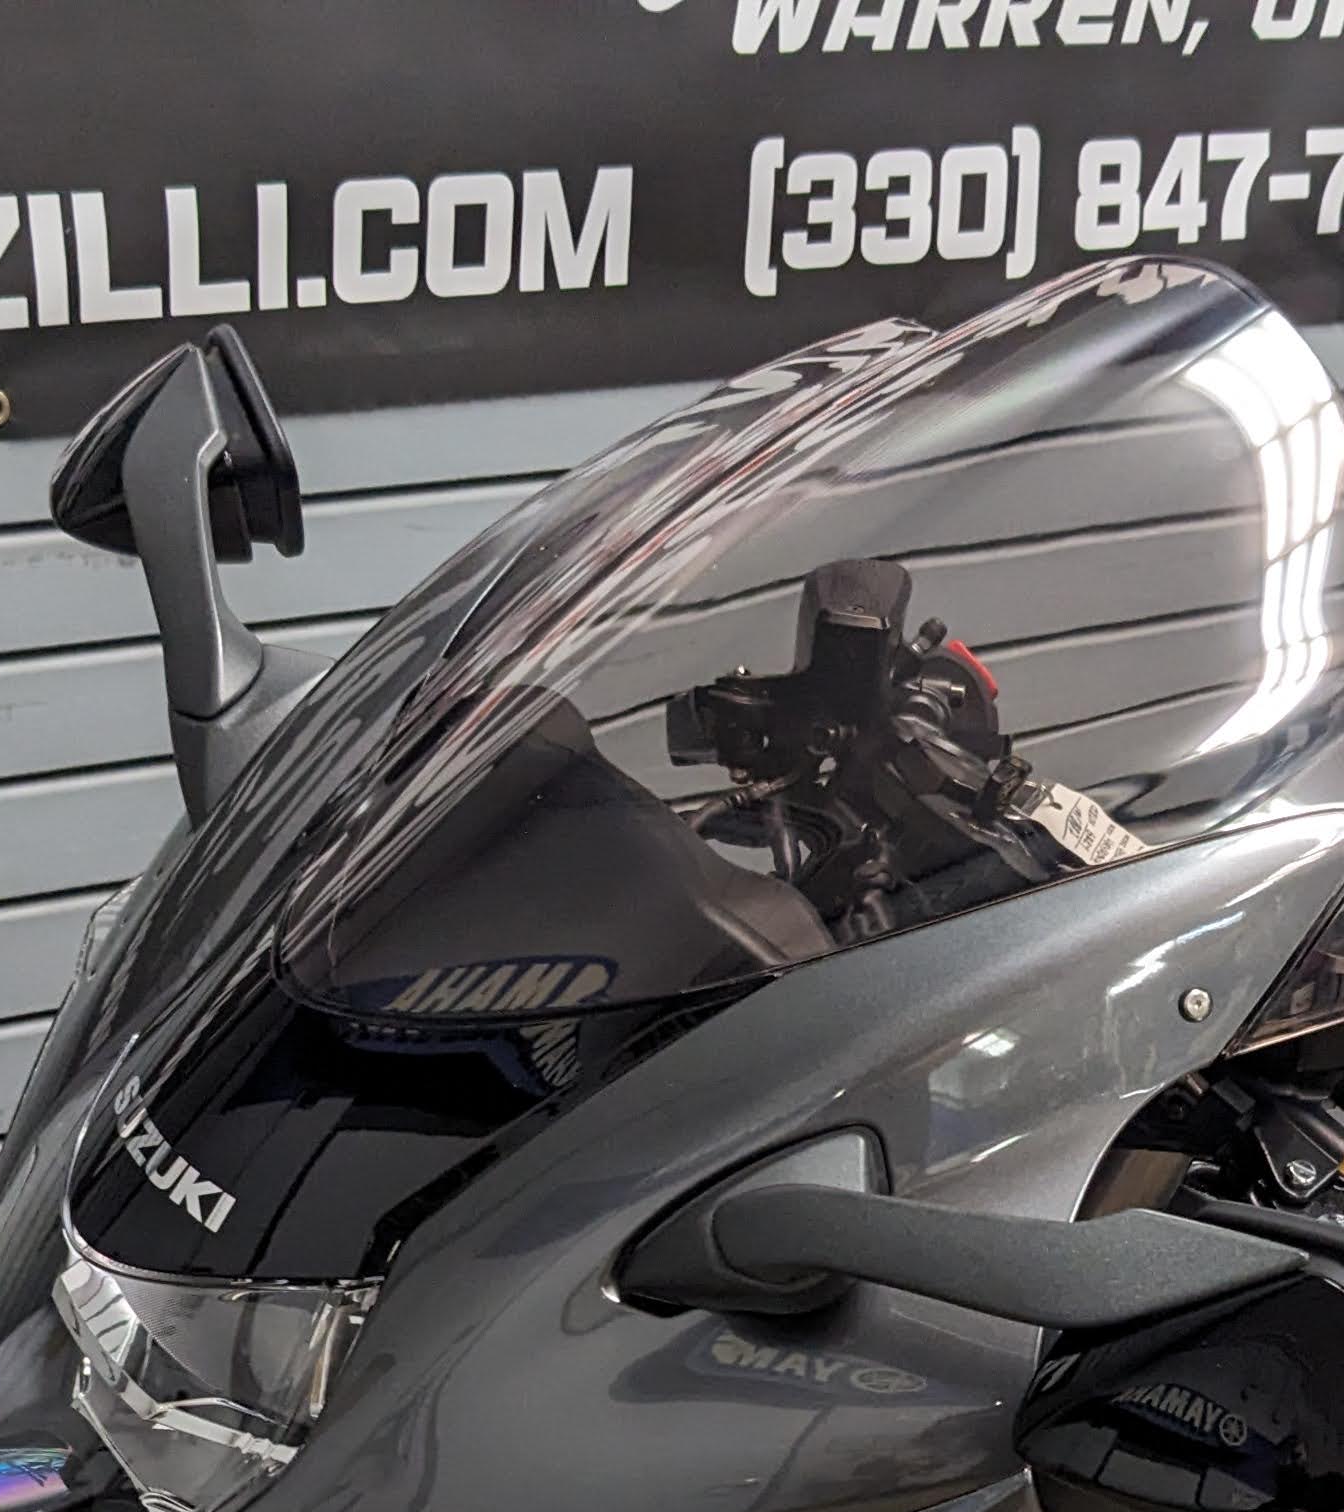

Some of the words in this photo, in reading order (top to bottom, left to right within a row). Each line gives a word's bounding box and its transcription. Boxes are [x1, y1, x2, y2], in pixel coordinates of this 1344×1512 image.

[731, 0, 1209, 55] WARREN,
[743, 125, 1042, 297] (330)
[114, 1075, 237, 1234] SUZUKI
